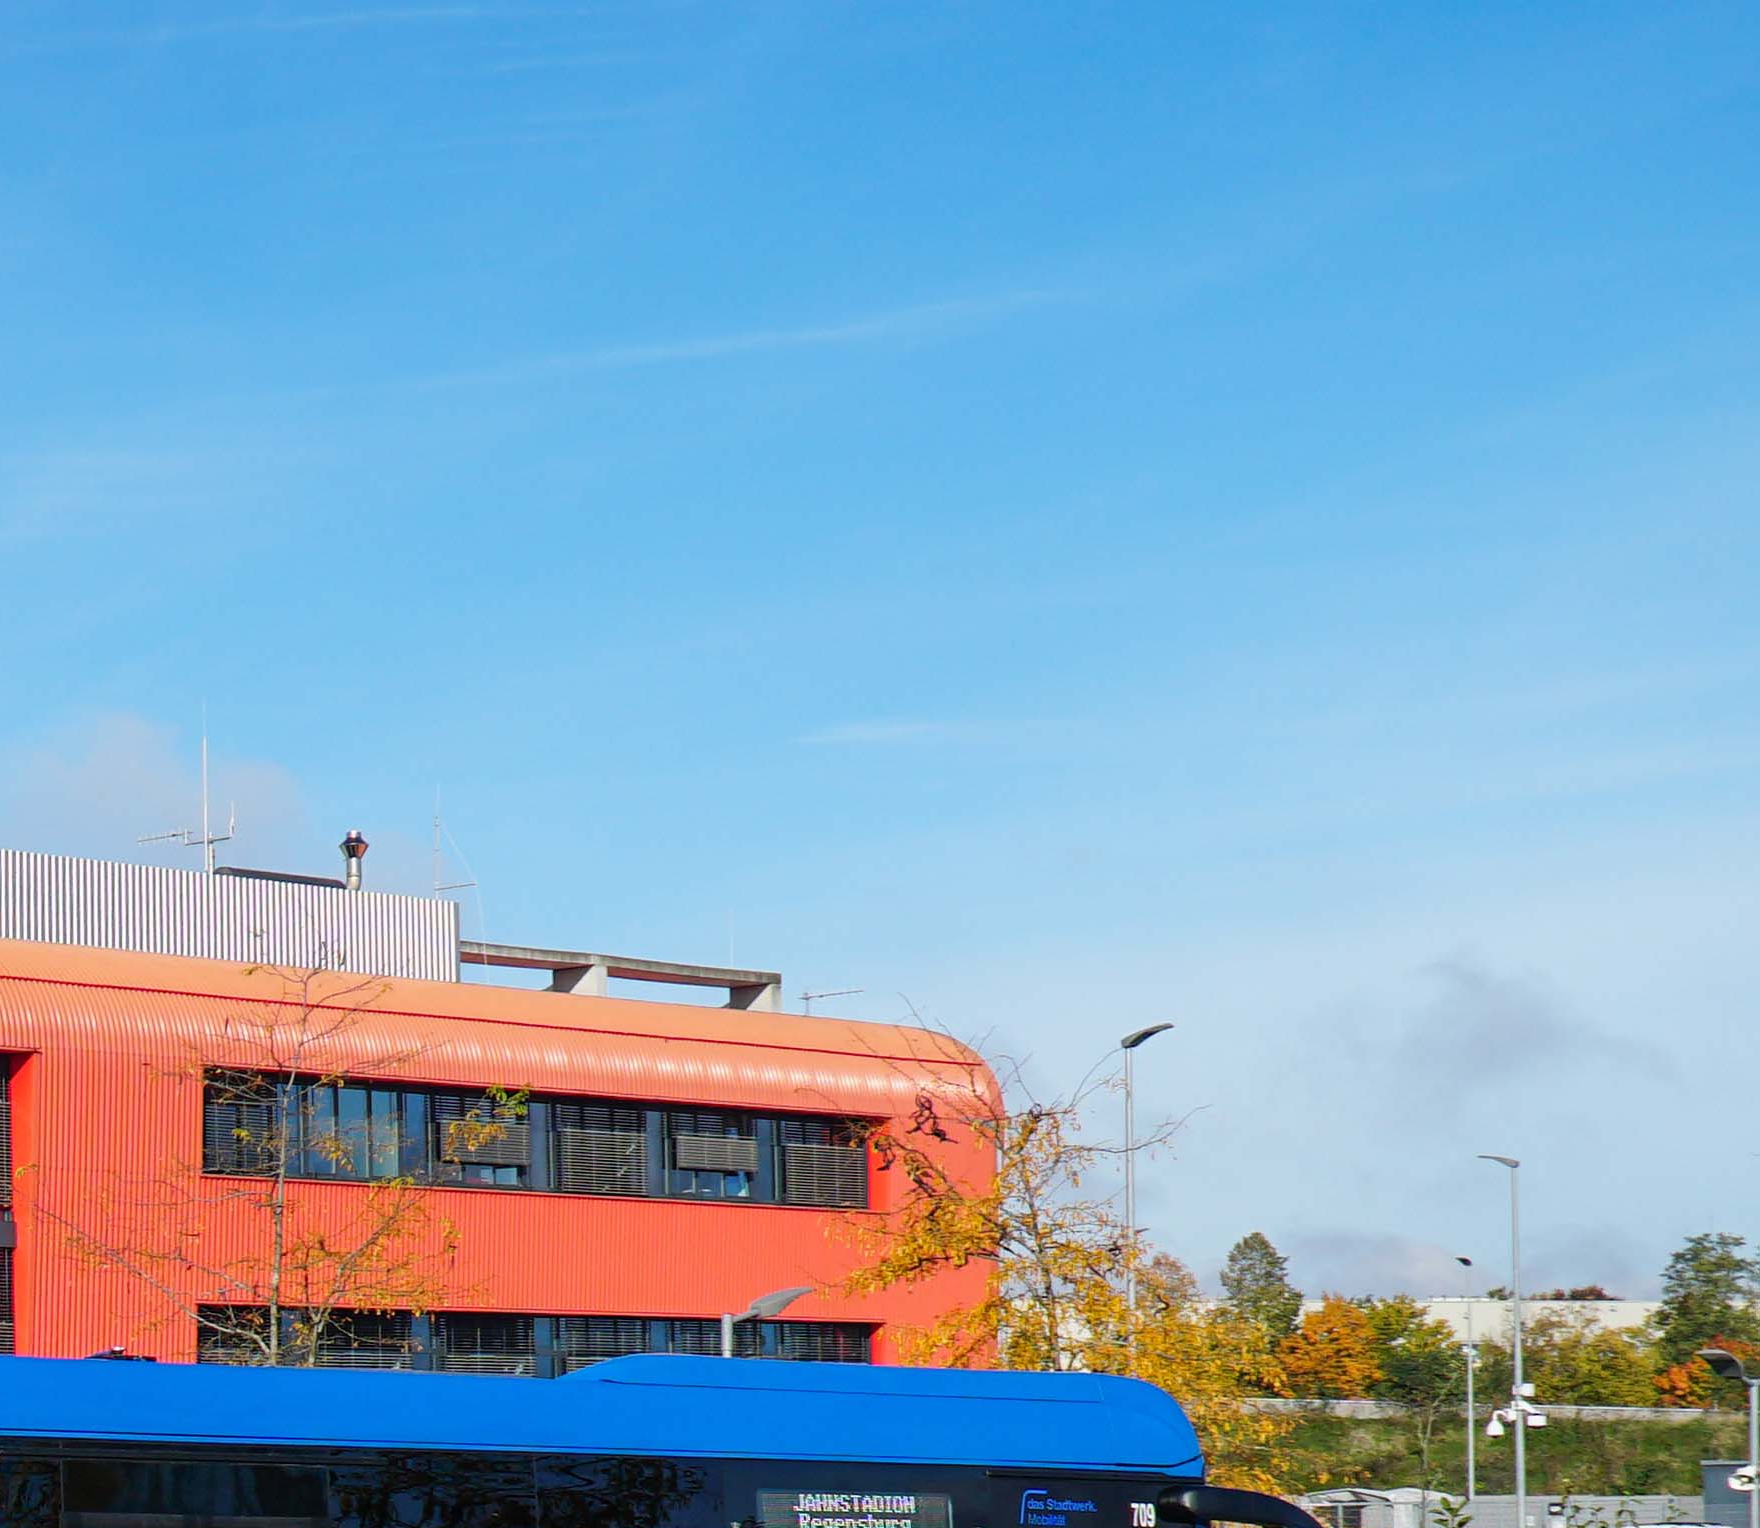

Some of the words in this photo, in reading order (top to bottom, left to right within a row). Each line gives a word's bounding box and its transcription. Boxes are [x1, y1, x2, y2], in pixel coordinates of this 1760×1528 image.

[792, 1493, 916, 1513] JAHNSTADION
[1027, 1498, 1044, 1510] das
[1130, 1502, 1156, 1528] 709
